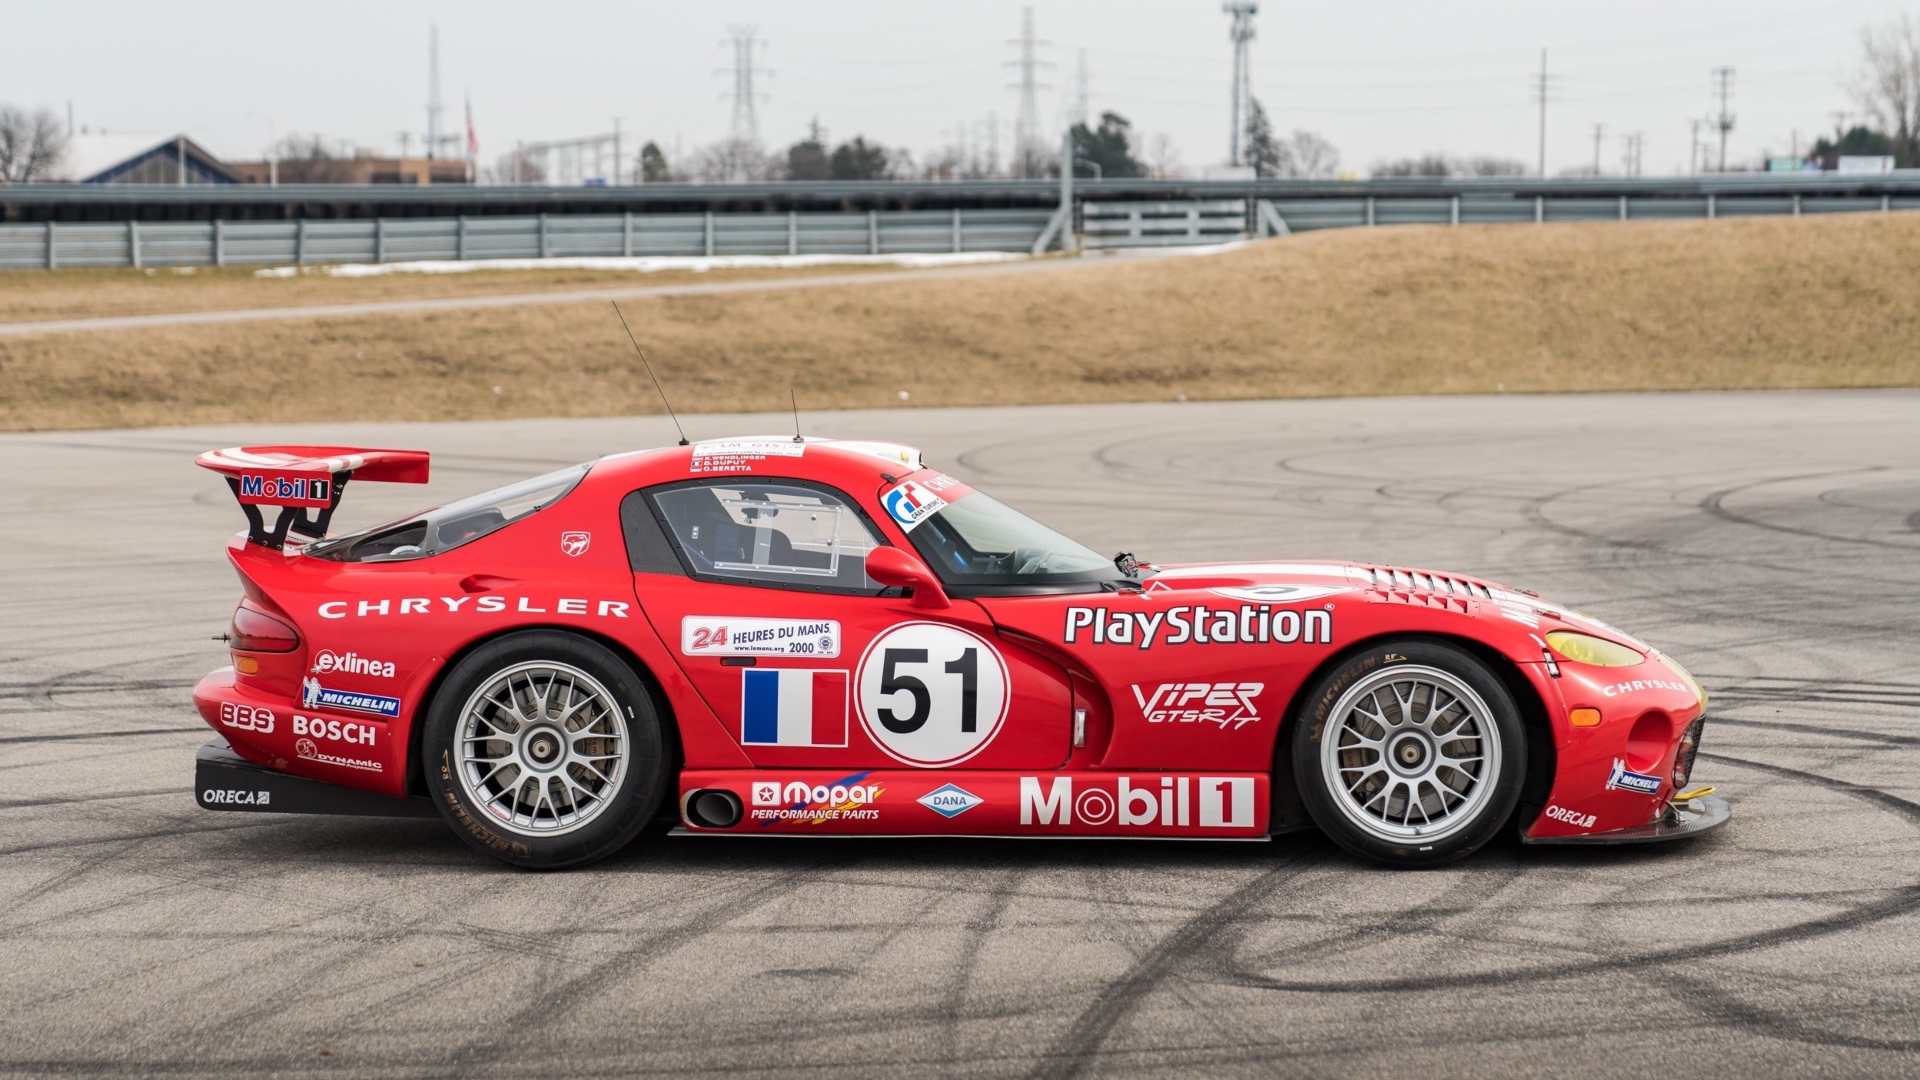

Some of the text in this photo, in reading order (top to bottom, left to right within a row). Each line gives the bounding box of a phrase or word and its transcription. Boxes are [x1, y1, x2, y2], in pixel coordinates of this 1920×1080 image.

[241, 475, 306, 499] Mobil
[318, 596, 630, 619] CHRYSLER
[692, 623, 830, 650] 24 HEURES DU MANS
[1064, 605, 1333, 650] PlayStation
[734, 645, 785, 653] www.lemans.org
[789, 643, 814, 654] 2000
[319, 653, 395, 677] exlinea
[877, 648, 977, 734] 51
[1603, 680, 1688, 696] CHRYSLER
[322, 693, 397, 711] MICHELIN
[220, 702, 275, 733] BBS
[293, 715, 376, 745] BOSCH
[1621, 775, 1660, 788] MICHELIN
[203, 789, 256, 804] ORECA
[783, 782, 878, 807] Mopar
[933, 796, 967, 806] DANA
[1020, 777, 1190, 826] Mobil
[751, 810, 879, 820] PERFORMANCE PARTS
[1546, 805, 1583, 827] ORECA
